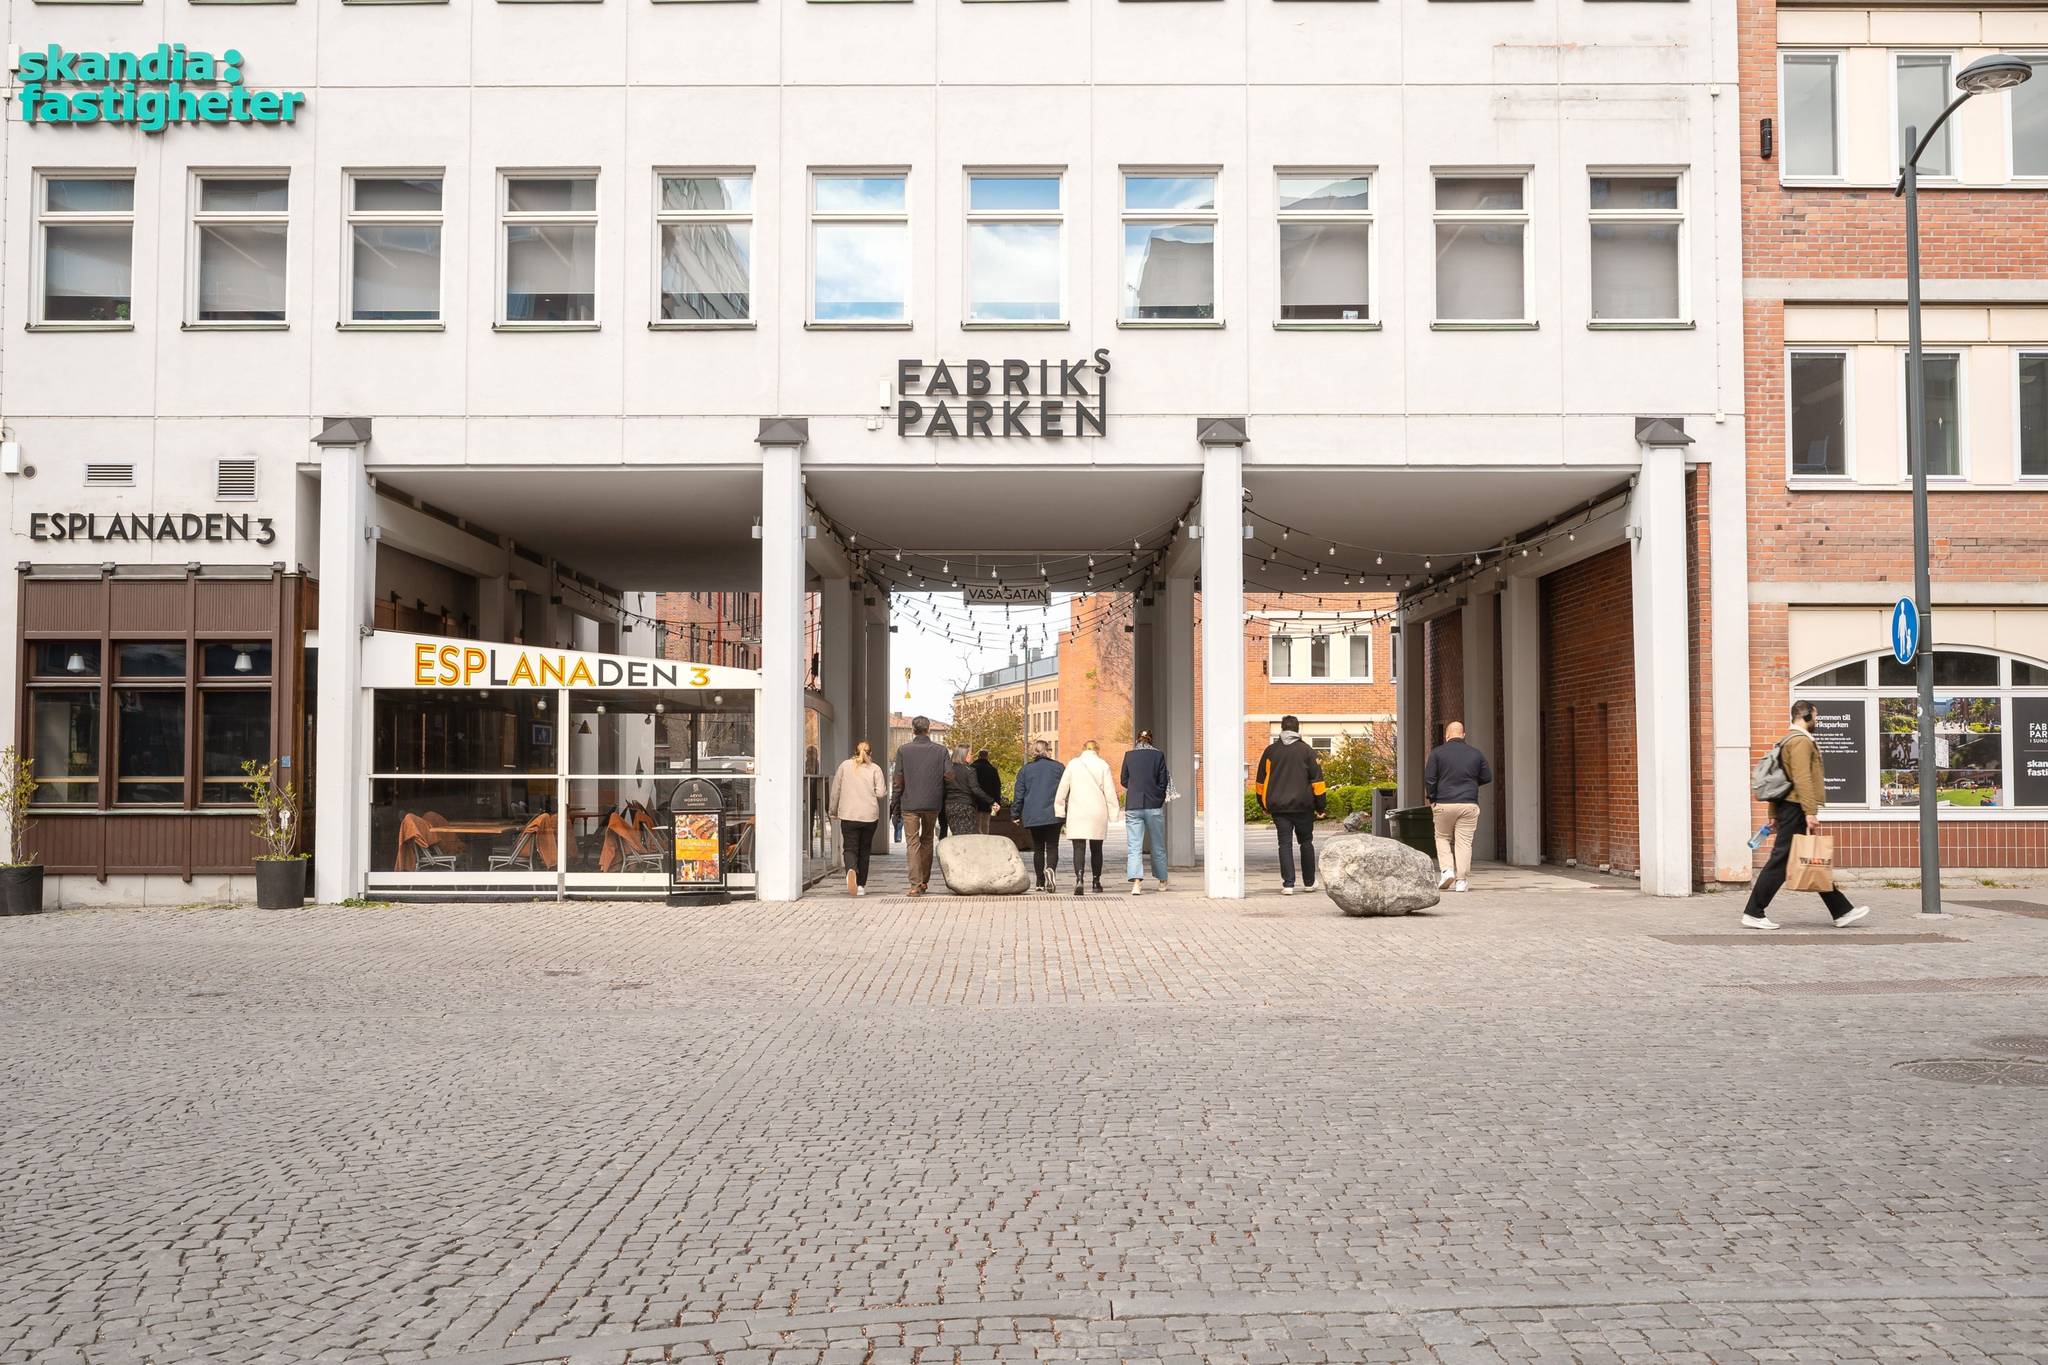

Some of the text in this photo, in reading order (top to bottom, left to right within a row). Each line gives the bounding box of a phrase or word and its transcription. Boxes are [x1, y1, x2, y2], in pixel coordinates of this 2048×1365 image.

[18, 82, 305, 133] fastigheter
[898, 348, 1111, 396] FABRIKS
[898, 376, 1107, 437] PARKEN
[30, 512, 276, 545] ESPLANADEN 3
[968, 588, 1047, 600] VASAGATAN
[414, 642, 711, 687] ESPLANADEN 3
